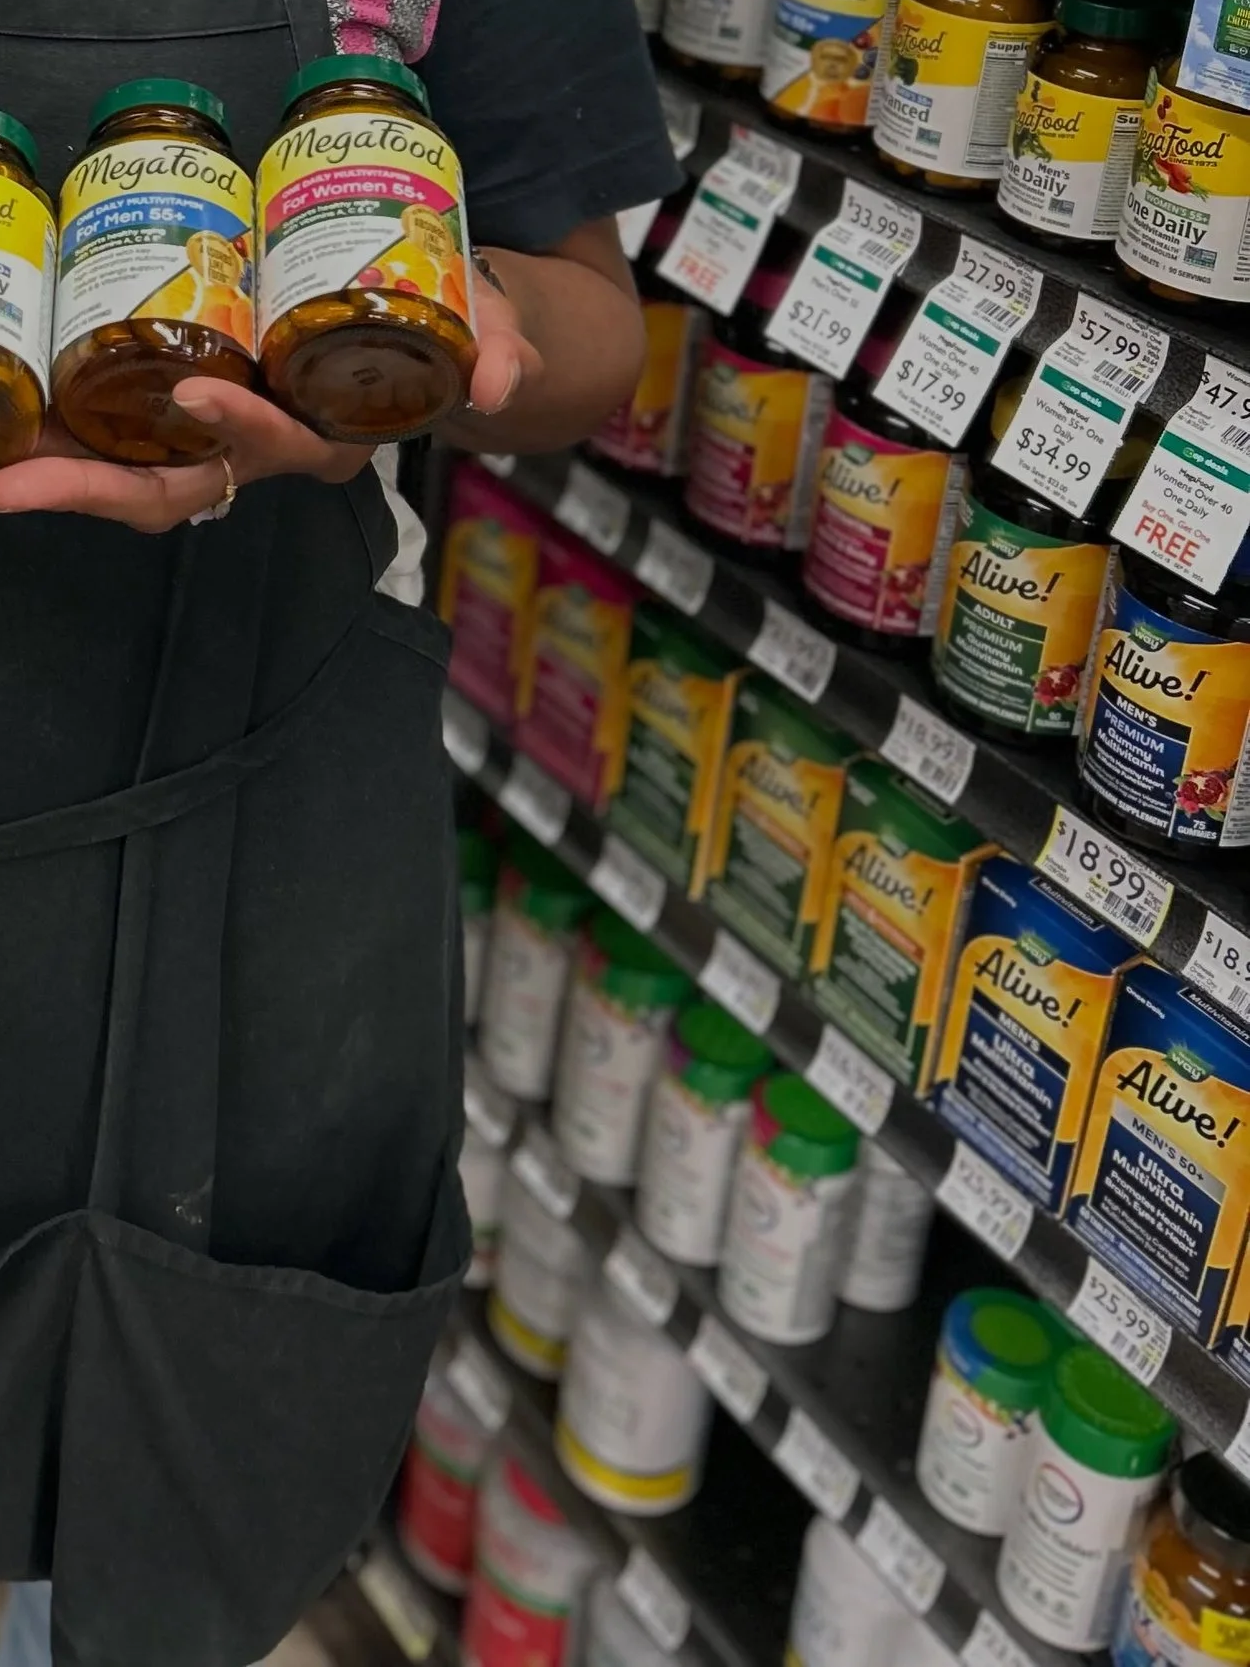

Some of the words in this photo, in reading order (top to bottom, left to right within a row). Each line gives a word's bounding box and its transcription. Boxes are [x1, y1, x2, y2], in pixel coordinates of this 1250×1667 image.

[275, 119, 446, 172] MegaFood
[1140, 123, 1225, 160] egaFood
[1169, 157, 1195, 166] SINCE
[74, 145, 238, 197] MegaFood
[1022, 168, 1067, 196] Daily
[1038, 163, 1070, 180] Men's
[95, 200, 125, 216] DAILY
[126, 196, 204, 210] MULTIVITAMIN
[282, 193, 309, 214] For
[313, 181, 387, 199] Women
[392, 185, 426, 202] 55+
[848, 195, 899, 240] $33.99
[1127, 192, 1149, 220] One
[1152, 209, 1207, 245] Daily
[1190, 209, 1208, 224] 55+
[76, 224, 100, 243] For
[104, 208, 144, 227] Men
[150, 208, 185, 222] 55+
[1134, 216, 1180, 245] Multivitamin
[961, 249, 1016, 299] $27.99
[1169, 266, 1177, 275] 90
[1178, 268, 1211, 284] SERVINGS
[788, 300, 851, 346] $21.99
[1079, 310, 1141, 362] $57.99
[918, 331, 947, 356] Women
[948, 352, 968, 369] Over
[923, 352, 940, 366] One
[896, 359, 966, 412] $17.99
[1035, 396, 1068, 426] Women
[1068, 416, 1085, 432] 55+
[1086, 427, 1105, 445] One
[1053, 423, 1075, 443] Daily
[1016, 427, 1092, 482] $34.99
[1204, 456, 1230, 476] deals
[1152, 465, 1193, 496] Womens
[1195, 488, 1219, 509] Over
[1220, 501, 1233, 515] 40
[1179, 467, 1215, 492] MegaFood
[1141, 499, 1156, 514] Buy
[1178, 519, 1192, 534] Get
[1193, 529, 1211, 544] One
[1163, 488, 1183, 506] One
[1185, 497, 1209, 519] Daily
[1134, 514, 1200, 568] FREE
[960, 550, 1065, 602] Alive!
[963, 616, 1023, 653] PREMIUM
[973, 604, 1016, 630] ADULT
[955, 635, 1023, 676] Multivitamin
[967, 634, 1011, 662] Gummy
[1134, 629, 1159, 650] way
[1104, 639, 1212, 701] Alive!
[1104, 709, 1164, 753] PREMIUM
[1116, 695, 1158, 727] MEN'S
[1097, 728, 1165, 777] Multivitamin
[1108, 728, 1152, 762] Gummy
[1118, 799, 1168, 829] SUPPLEMENT
[1178, 826, 1216, 839] GUMMIES
[1193, 820, 1206, 830] 75
[844, 843, 936, 916] Alive!
[1056, 820, 1146, 901] $18.99
[975, 948, 1087, 1028] Alive!
[999, 1012, 1040, 1053] MEN'S
[1188, 992, 1250, 1041] Multivitamin
[971, 1032, 1053, 1109] Multivitamin
[993, 1034, 1035, 1079] Ultra
[1171, 1055, 1206, 1081] way
[1116, 1059, 1247, 1149] Alive!
[1131, 1116, 1177, 1160] MEN'S
[1178, 1156, 1205, 1182] 50+
[1112, 1149, 1203, 1233] Multivitamin
[1138, 1151, 1184, 1201] Ultra
[1104, 1177, 1132, 1207] Brain,
[1133, 1201, 1155, 1225] Eyes
[1110, 1170, 1154, 1212] Promotes
[1156, 1206, 1196, 1247] Healthy
[1089, 1276, 1150, 1339] $25.99
